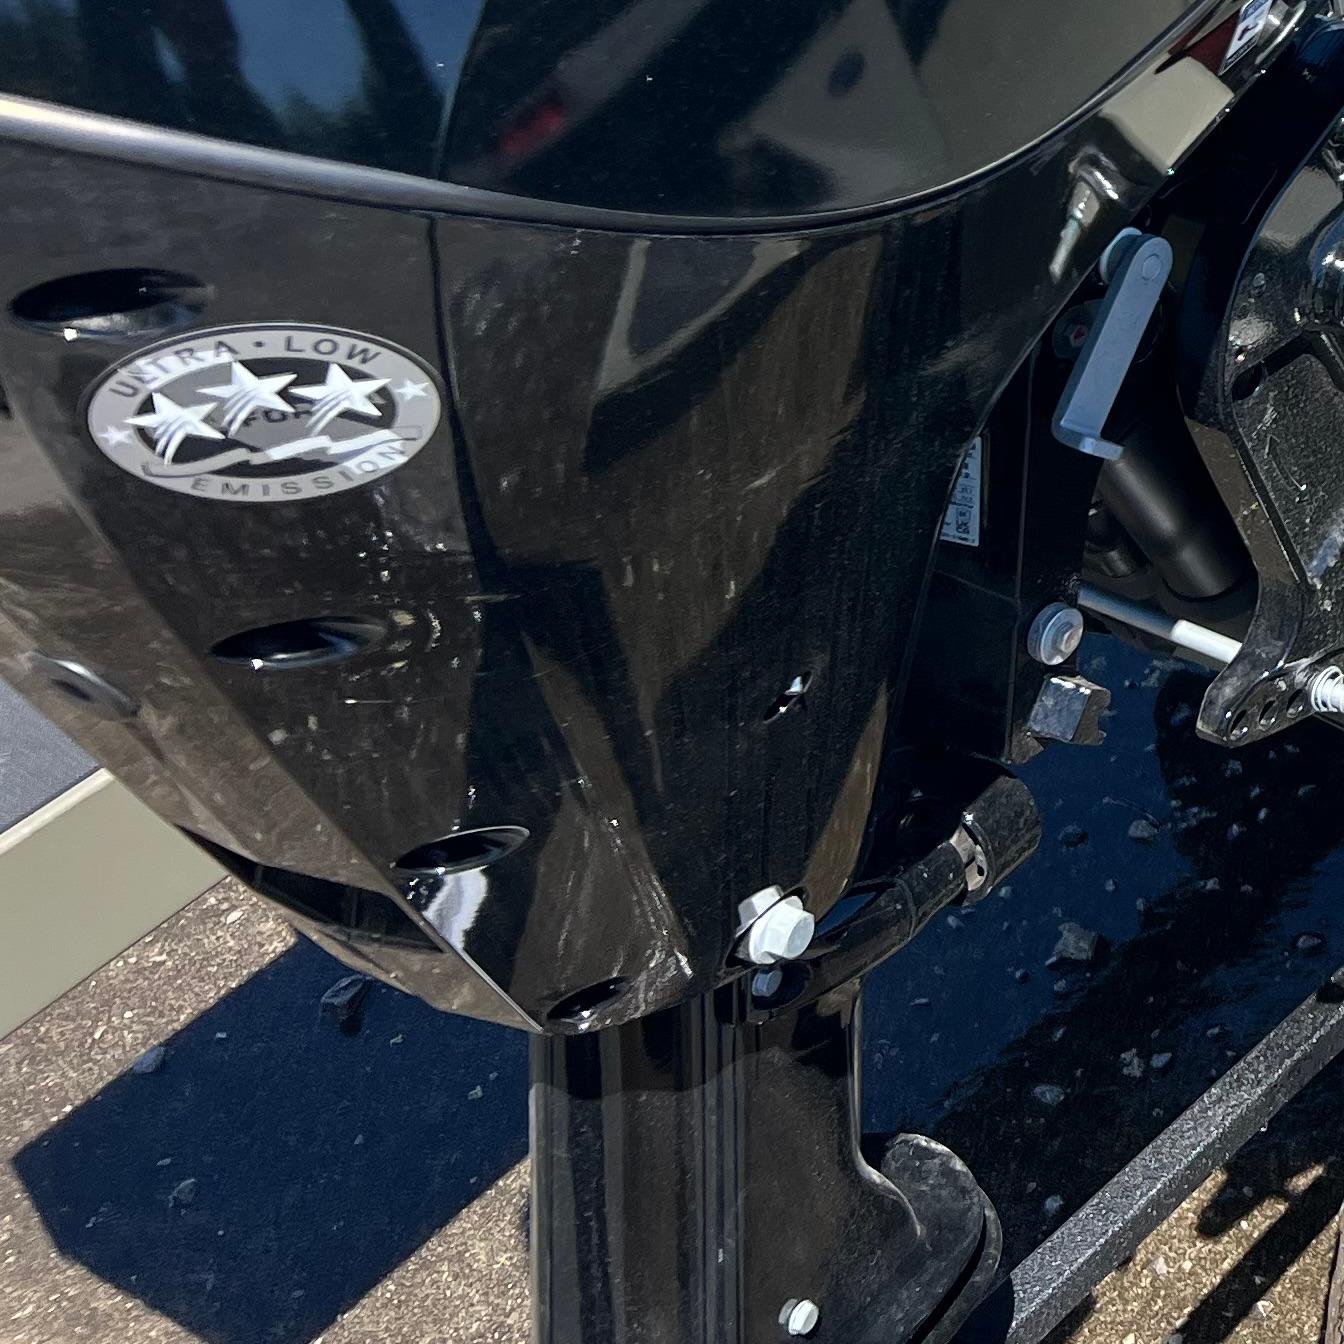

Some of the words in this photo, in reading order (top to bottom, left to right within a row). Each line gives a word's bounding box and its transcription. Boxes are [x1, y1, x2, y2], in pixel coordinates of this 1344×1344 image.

[109, 340, 239, 399] ULTRA
[284, 335, 382, 365] LOW
[190, 444, 405, 497] EMISSION
